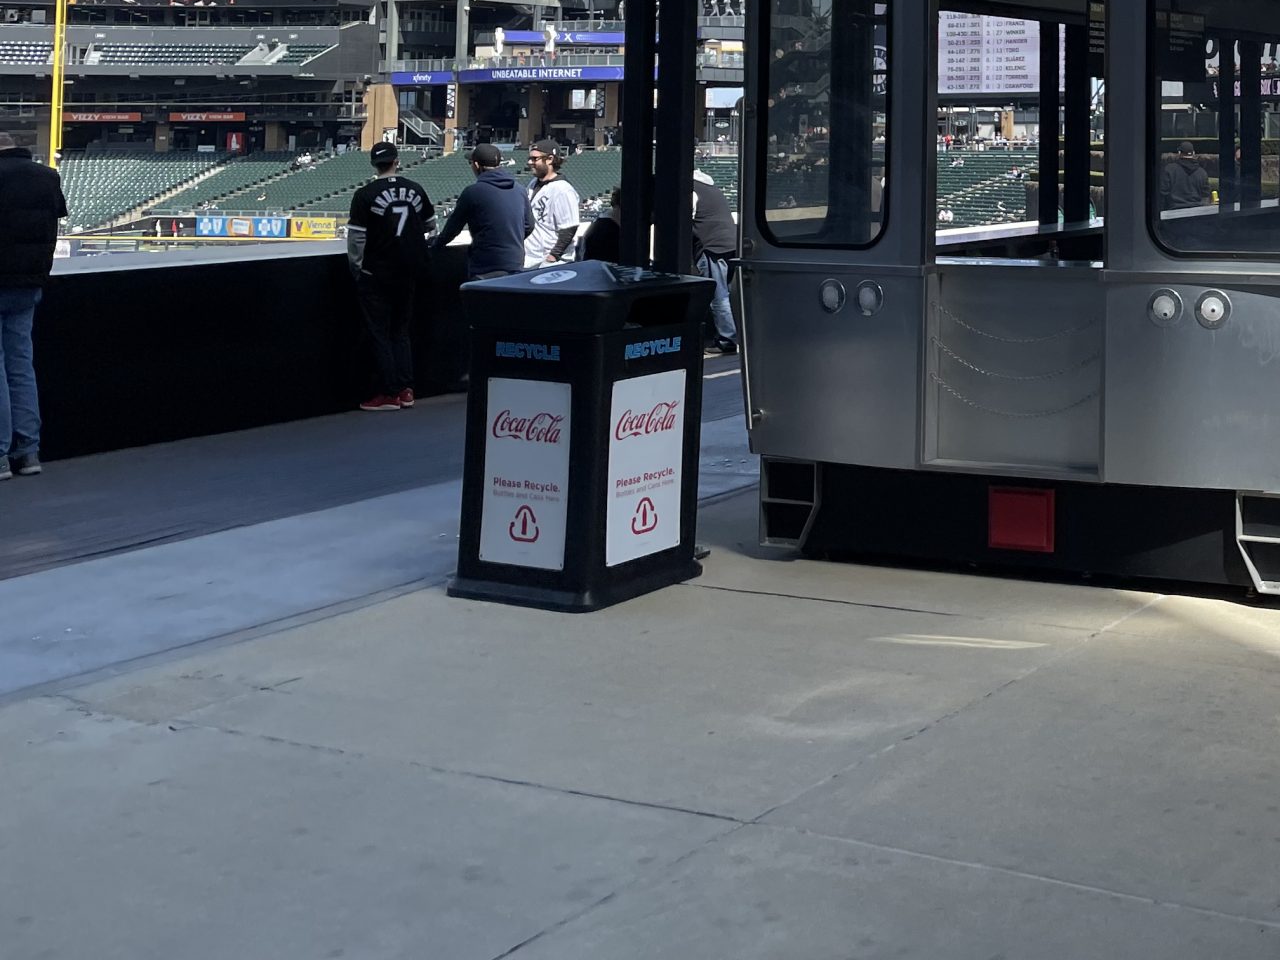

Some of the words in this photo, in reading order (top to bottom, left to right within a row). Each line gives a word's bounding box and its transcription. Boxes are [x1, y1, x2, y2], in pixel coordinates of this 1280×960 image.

[412, 73, 432, 83] xfinity
[491, 68, 537, 80] UNBEATABLE
[539, 67, 583, 79] INTERNET
[71, 113, 100, 121] VIZZY
[181, 113, 207, 121] VIZZY
[307, 220, 333, 229] Vienna
[392, 206, 409, 237] 7
[496, 341, 561, 362] RECYCLE
[624, 336, 682, 361] RECYCLE
[492, 409, 564, 444] Coca-Cola
[615, 400, 681, 441] Coca-Cola
[493, 476, 521, 489] Please
[524, 479, 560, 494] Recycle.
[616, 473, 641, 489] Please
[643, 467, 675, 483] Recycle.
